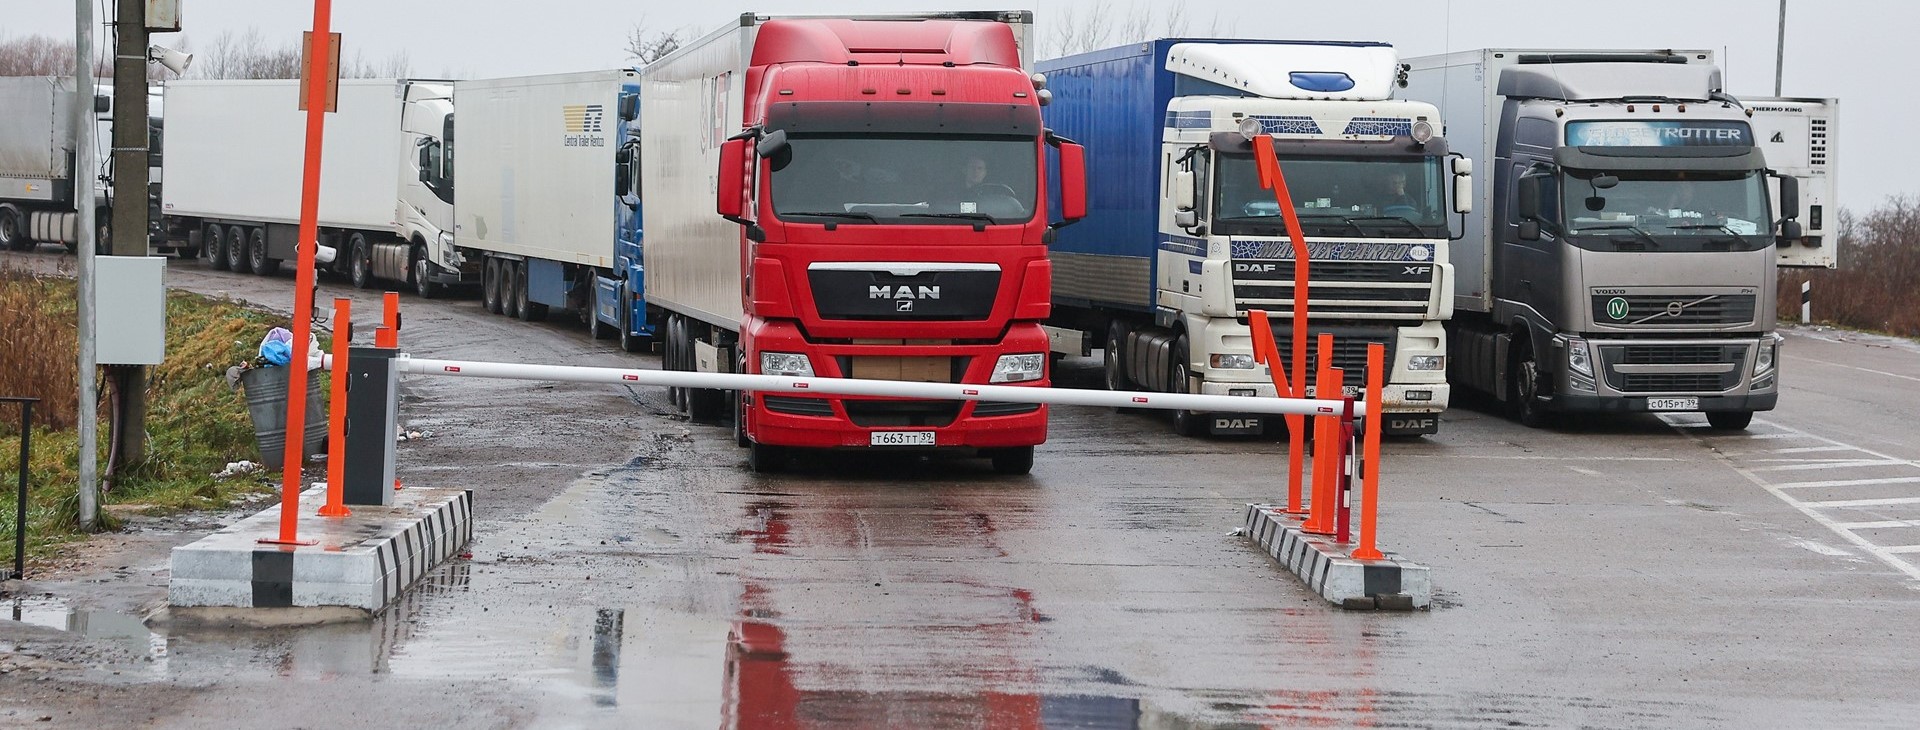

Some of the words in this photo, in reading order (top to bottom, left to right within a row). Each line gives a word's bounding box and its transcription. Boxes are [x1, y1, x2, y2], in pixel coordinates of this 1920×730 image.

[1339, 243, 1409, 260] CARGO
[1411, 249, 1428, 257] RUS
[1235, 263, 1276, 272] DAF
[1401, 266, 1431, 275] XF
[869, 285, 940, 299] MAN
[1611, 302, 1624, 315] IV
[1215, 418, 1258, 428] DAF
[1391, 419, 1433, 428] DAF
